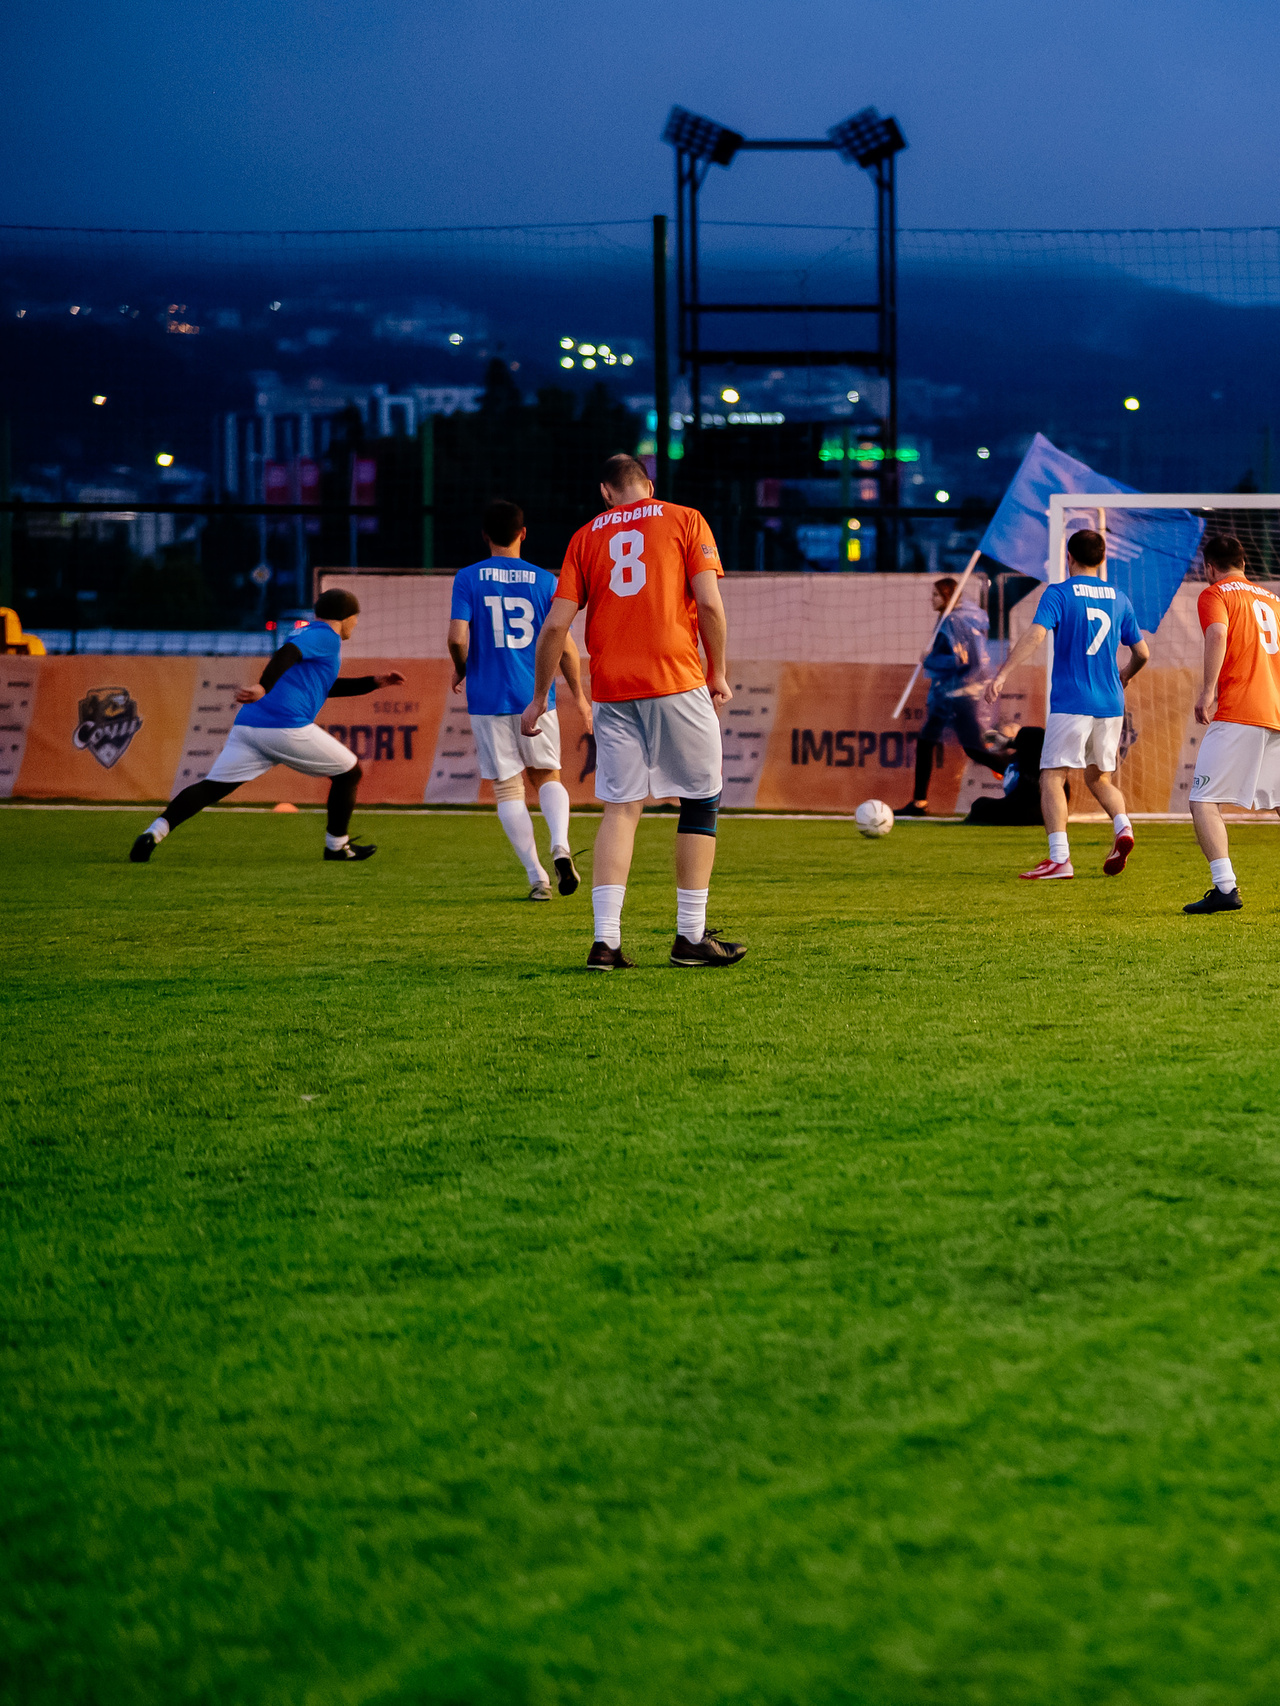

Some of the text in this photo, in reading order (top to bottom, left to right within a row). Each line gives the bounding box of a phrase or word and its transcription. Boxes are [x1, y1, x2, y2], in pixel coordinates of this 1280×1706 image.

[591, 504, 664, 532] ДУБОВИК
[609, 529, 647, 598] 8
[484, 595, 535, 649] 13
[1086, 607, 1111, 655] 7
[1252, 598, 1279, 655] 9
